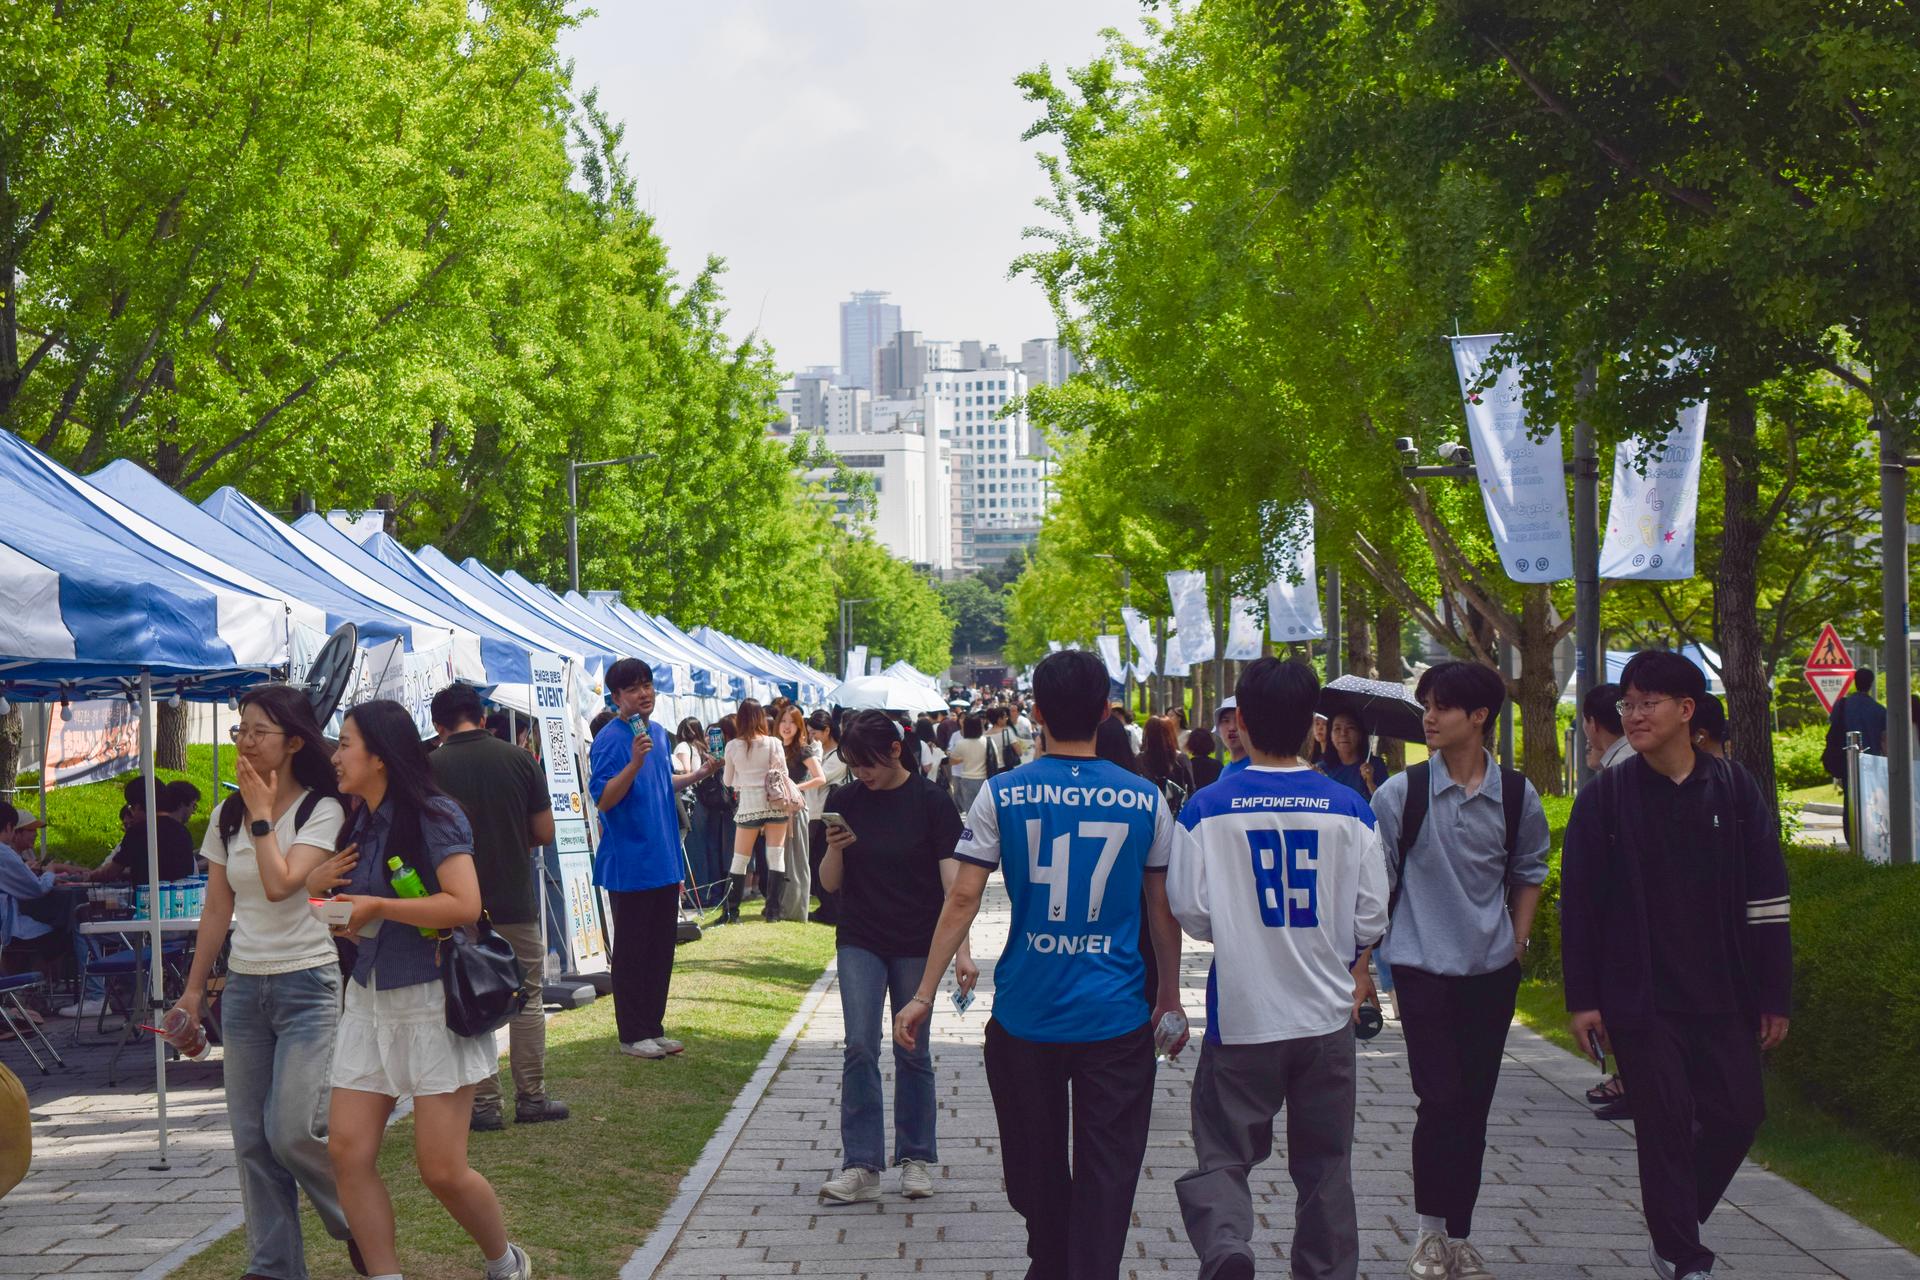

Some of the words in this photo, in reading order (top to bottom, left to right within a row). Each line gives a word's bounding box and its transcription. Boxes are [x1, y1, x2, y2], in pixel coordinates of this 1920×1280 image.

[537, 686, 564, 708] EVENT
[999, 785, 1153, 812] SEUNGYOON
[1231, 796, 1330, 810] EMPOWERING
[1026, 818, 1129, 922] 47
[1245, 829, 1319, 928] 85
[1026, 932, 1111, 955] YONSEI
